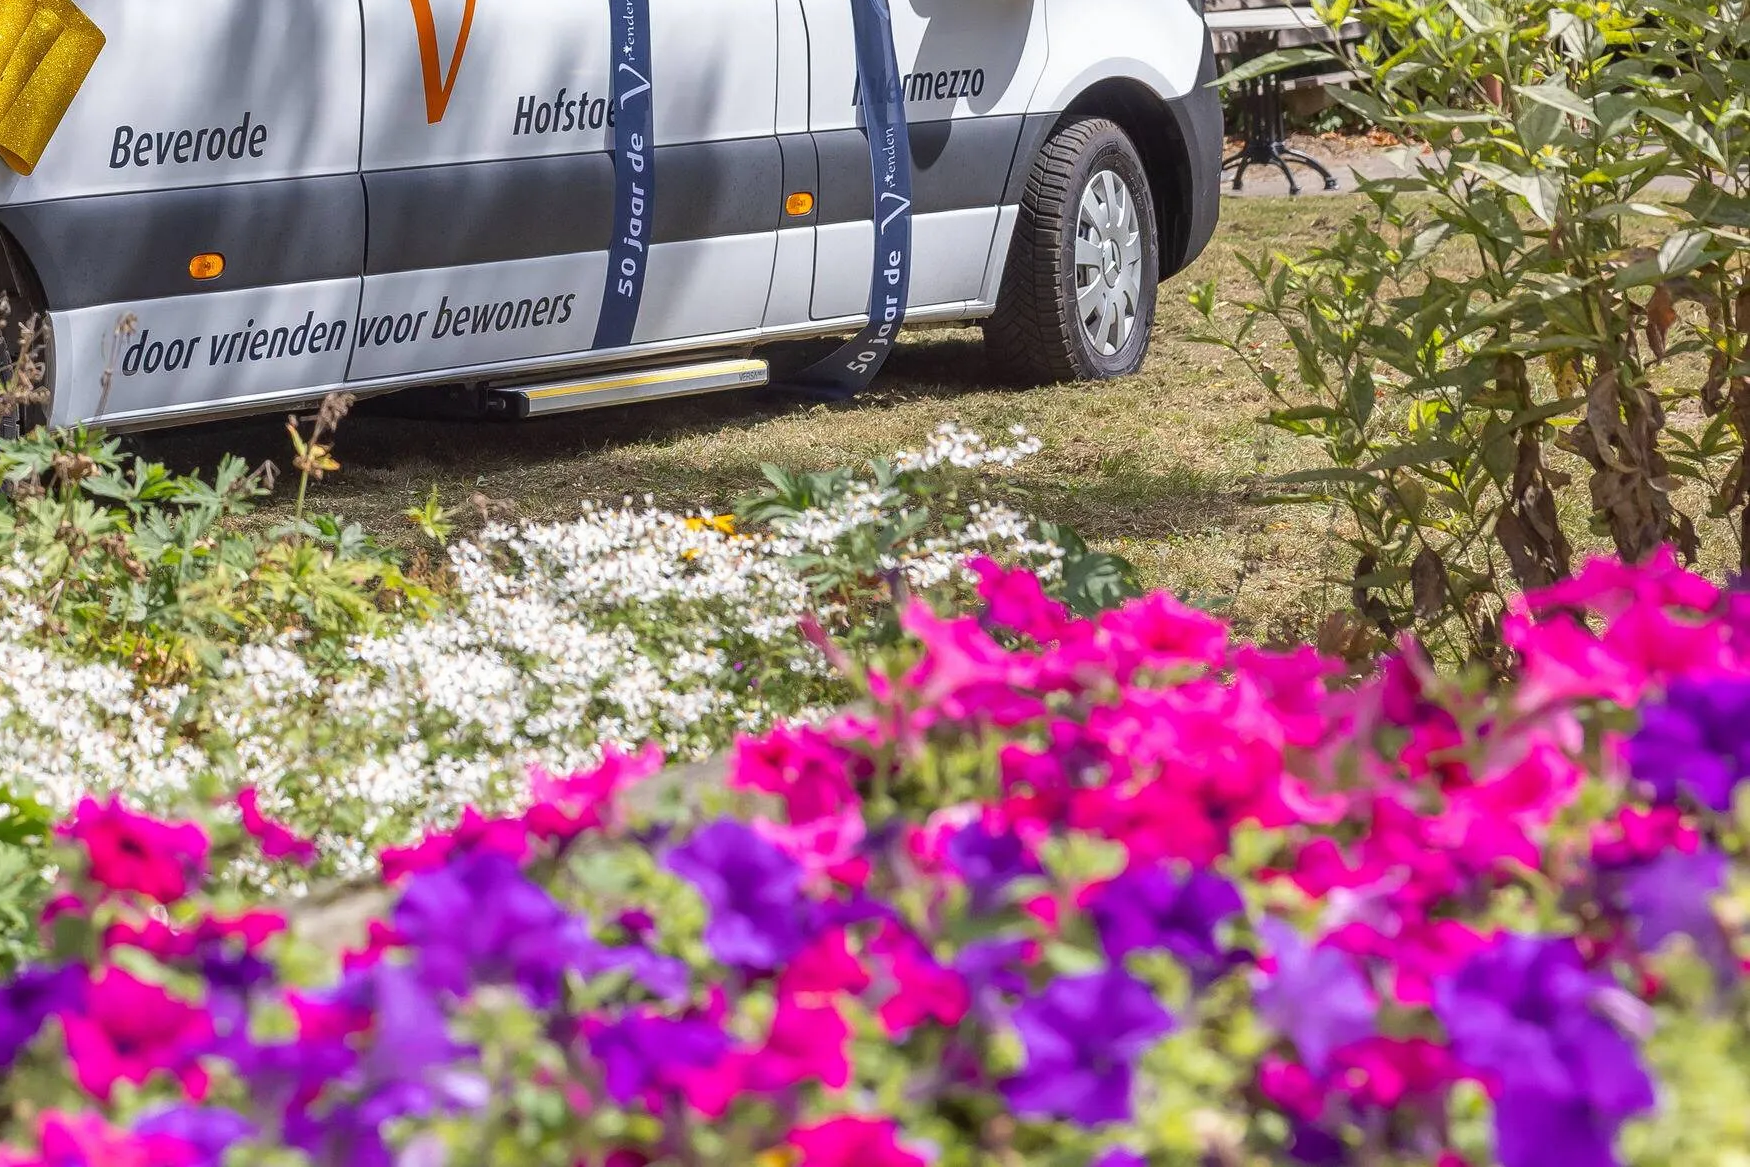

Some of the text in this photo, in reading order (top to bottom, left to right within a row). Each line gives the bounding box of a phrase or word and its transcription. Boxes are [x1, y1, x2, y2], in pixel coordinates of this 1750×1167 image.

[851, 68, 985, 107] Irmezzo
[108, 111, 267, 169] Beverode
[626, 132, 644, 173] de
[624, 182, 645, 252] jaar
[617, 257, 637, 298] 50
[846, 127, 911, 374] 50 jaar de Vrienden
[121, 291, 577, 376] door vrienden voor bewoners
